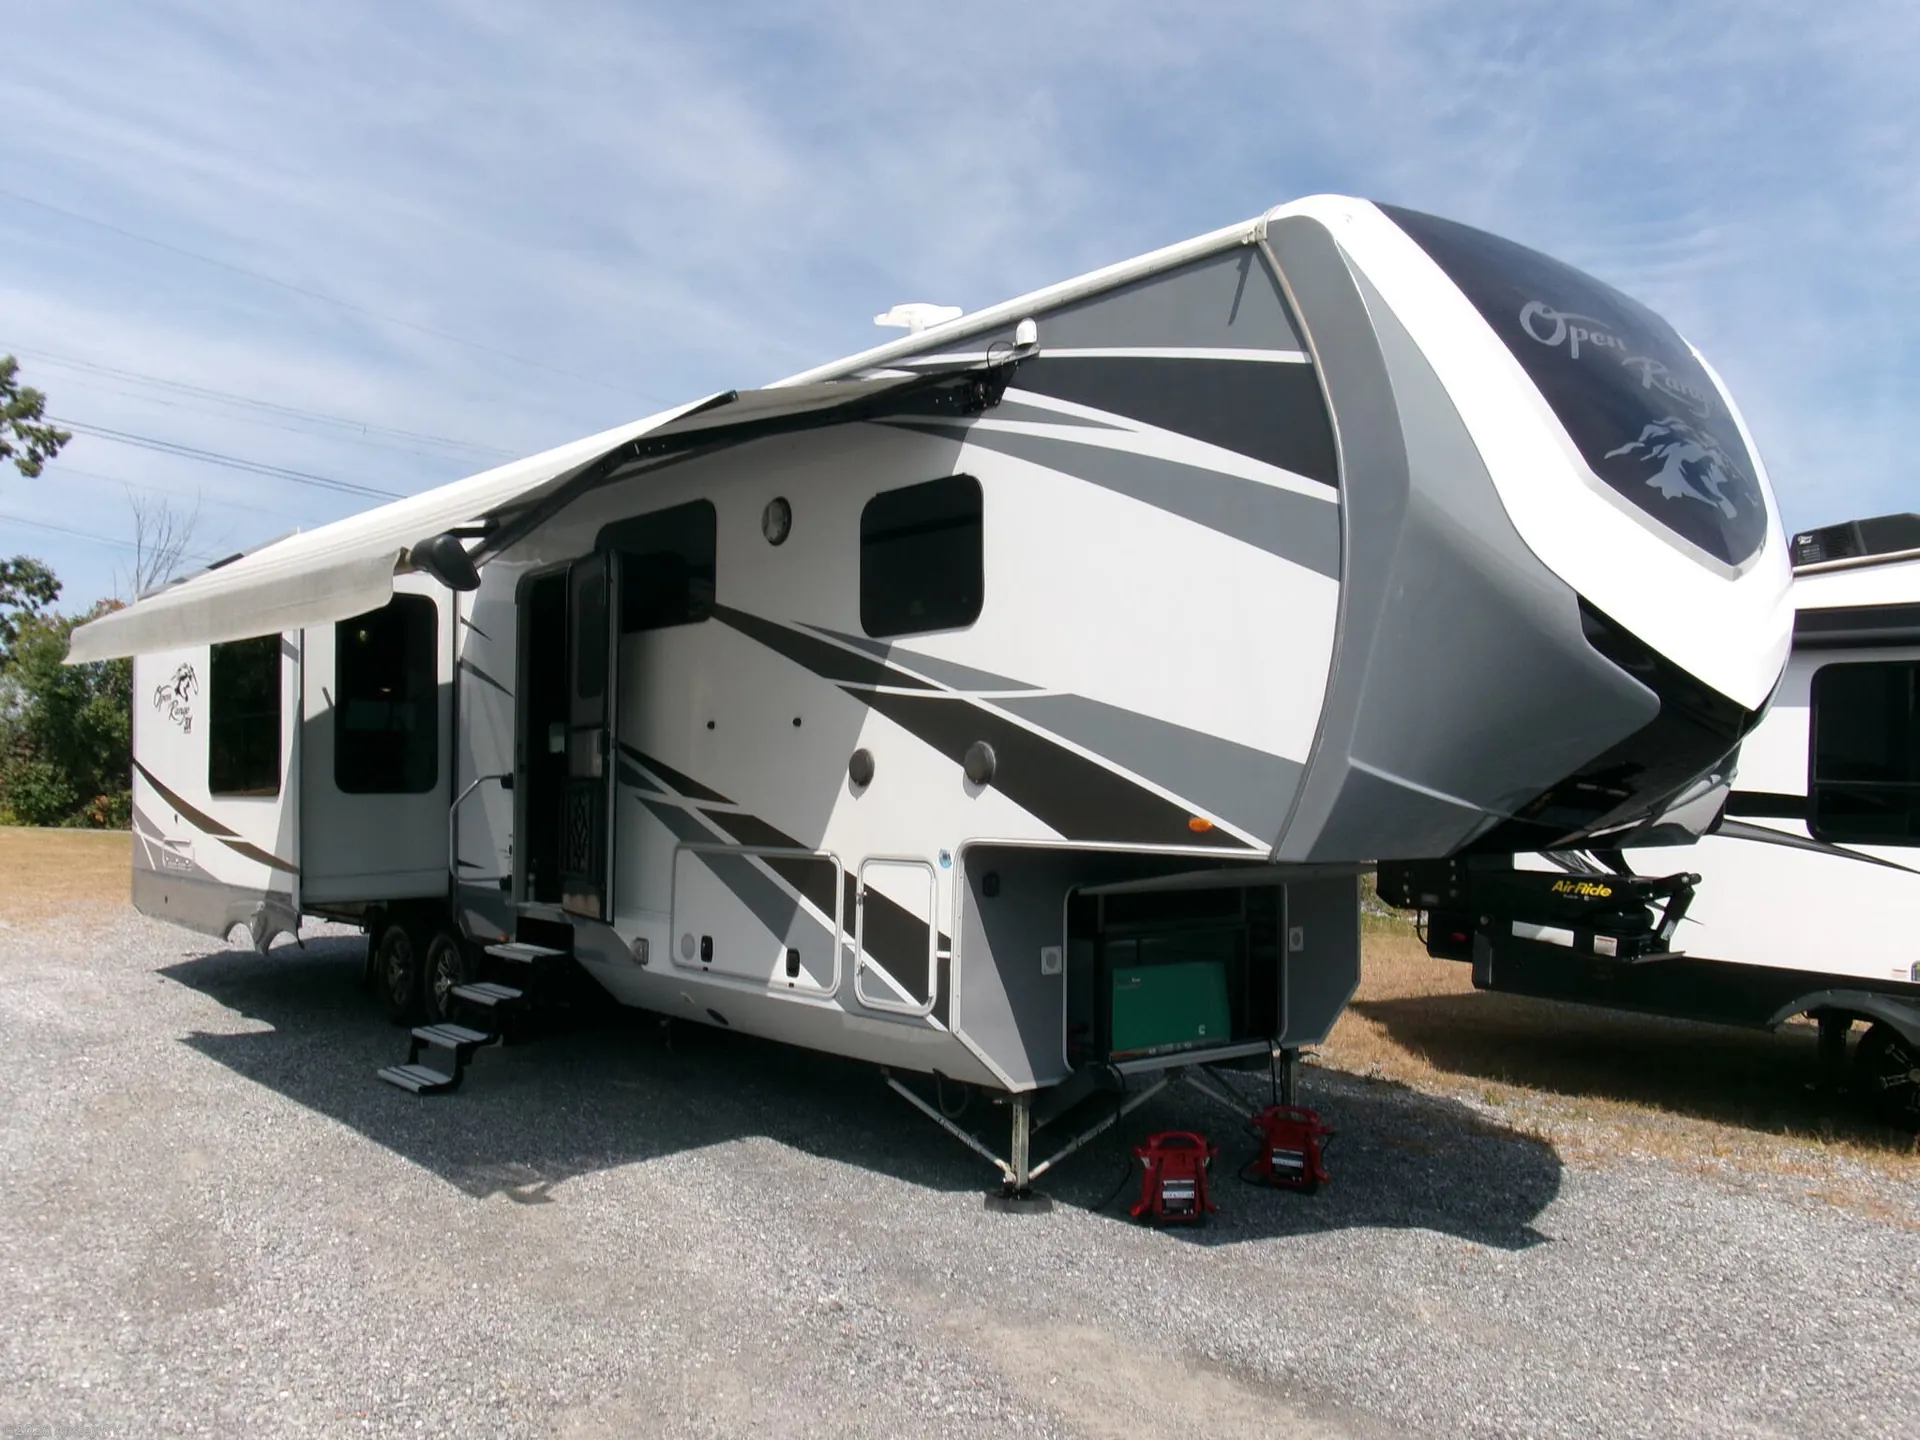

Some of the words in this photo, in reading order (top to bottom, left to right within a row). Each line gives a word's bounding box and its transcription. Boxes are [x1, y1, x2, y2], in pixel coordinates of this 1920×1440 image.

[1519, 300, 1626, 359] Open
[153, 684, 172, 712] Open
[168, 699, 190, 726] Range
